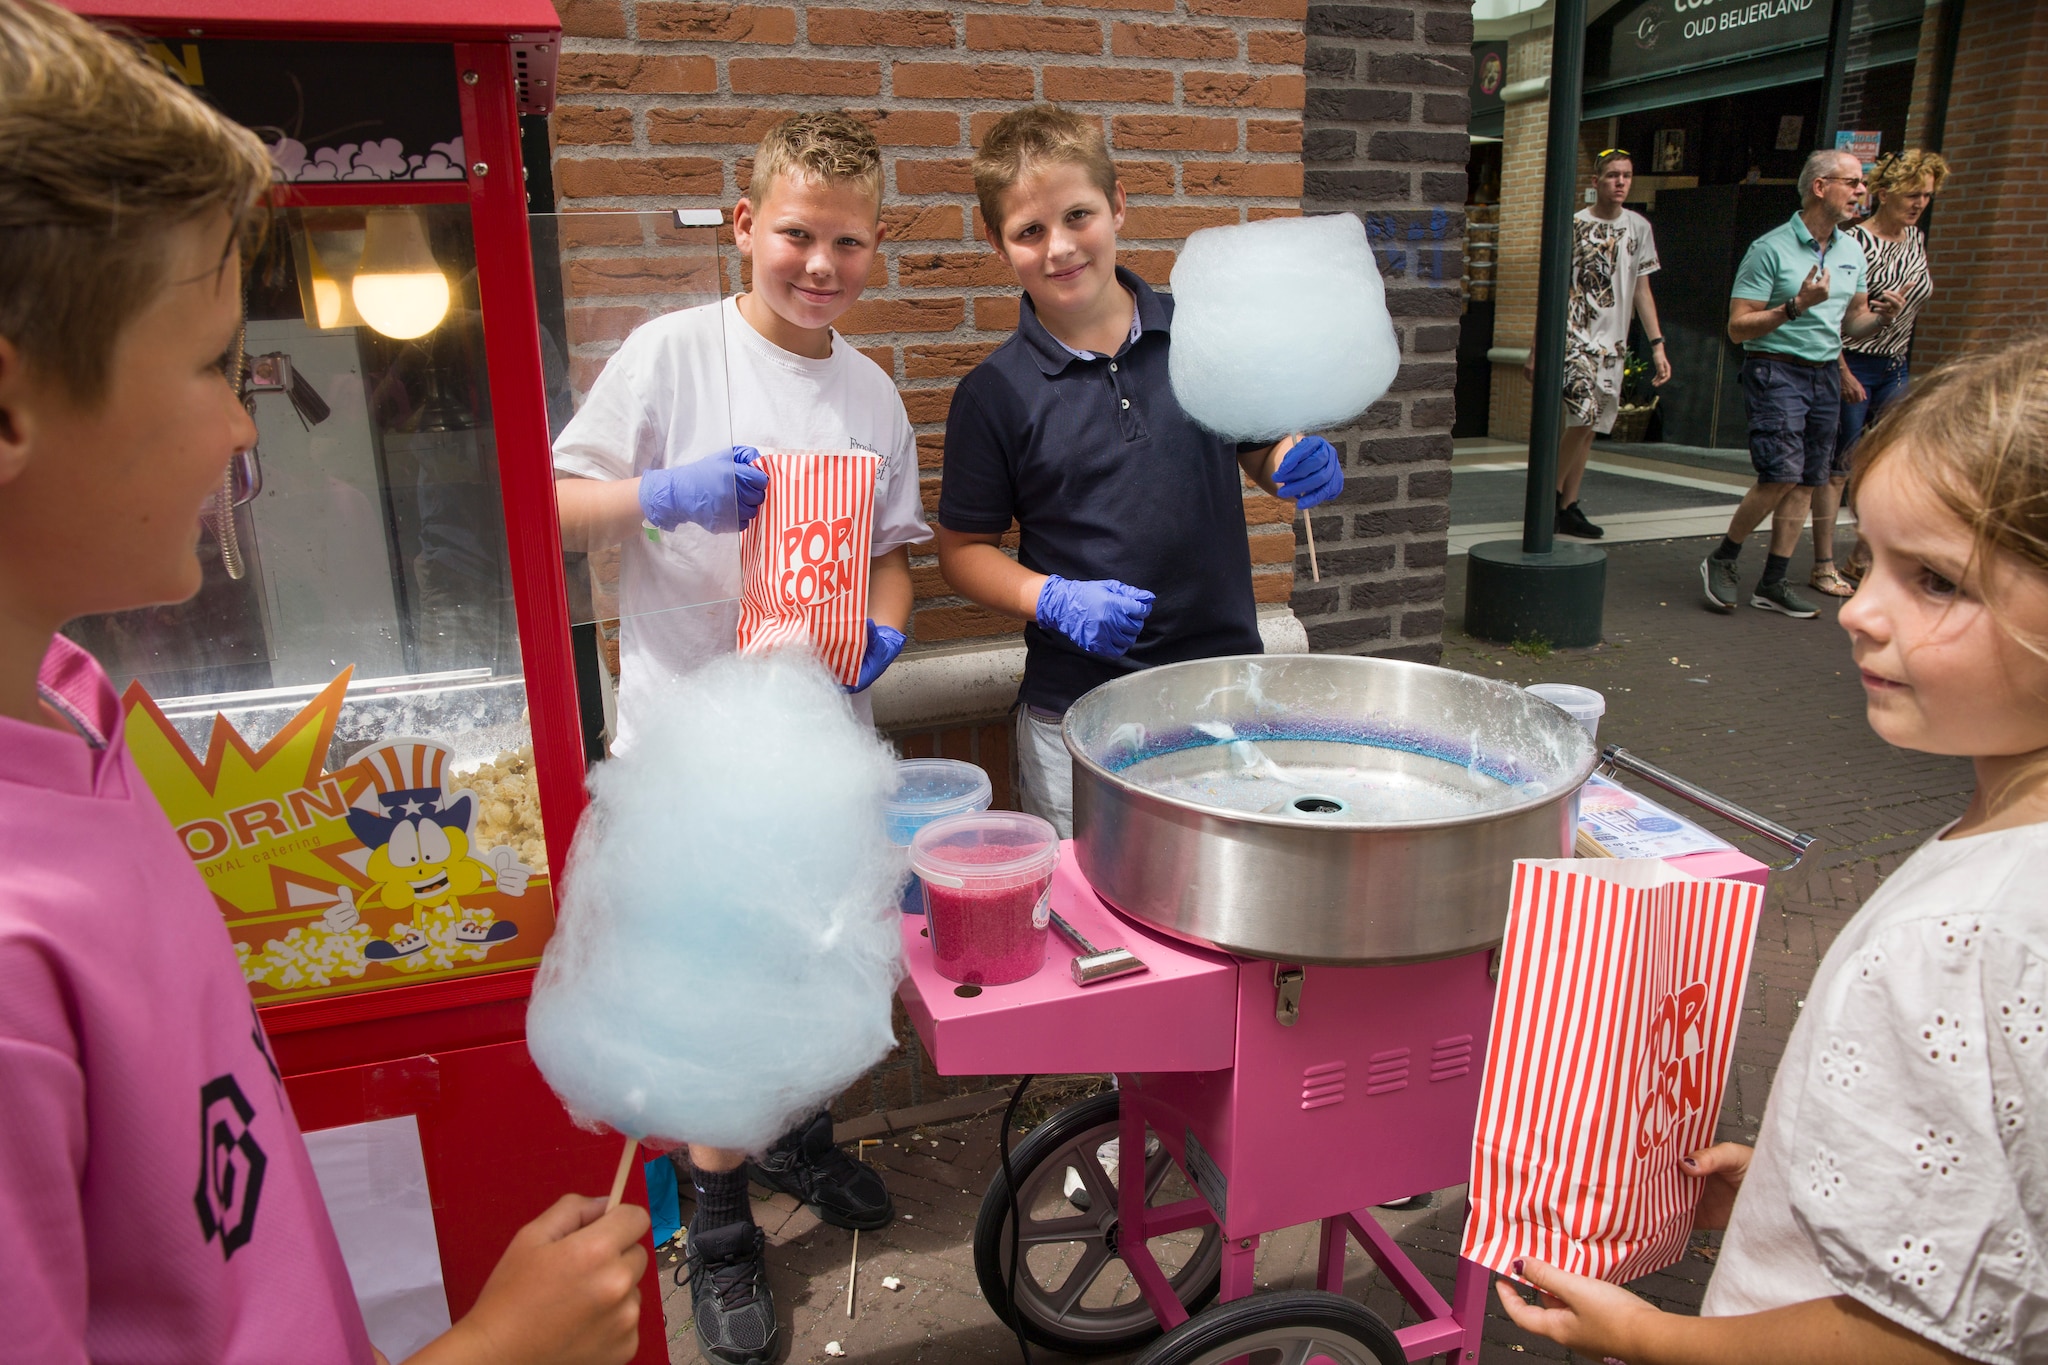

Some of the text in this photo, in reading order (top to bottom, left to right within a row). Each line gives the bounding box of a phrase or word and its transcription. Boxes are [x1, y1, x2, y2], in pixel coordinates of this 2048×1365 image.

[1683, 16, 1717, 39] OUD
[1719, 0, 1813, 31] BEIJERLAND
[783, 517, 853, 570] POP
[780, 556, 854, 607] CORN
[176, 777, 351, 864] ORN
[204, 836, 322, 878] OYAL catering
[1647, 982, 1707, 1093] POP
[1634, 1049, 1705, 1162] CORN
